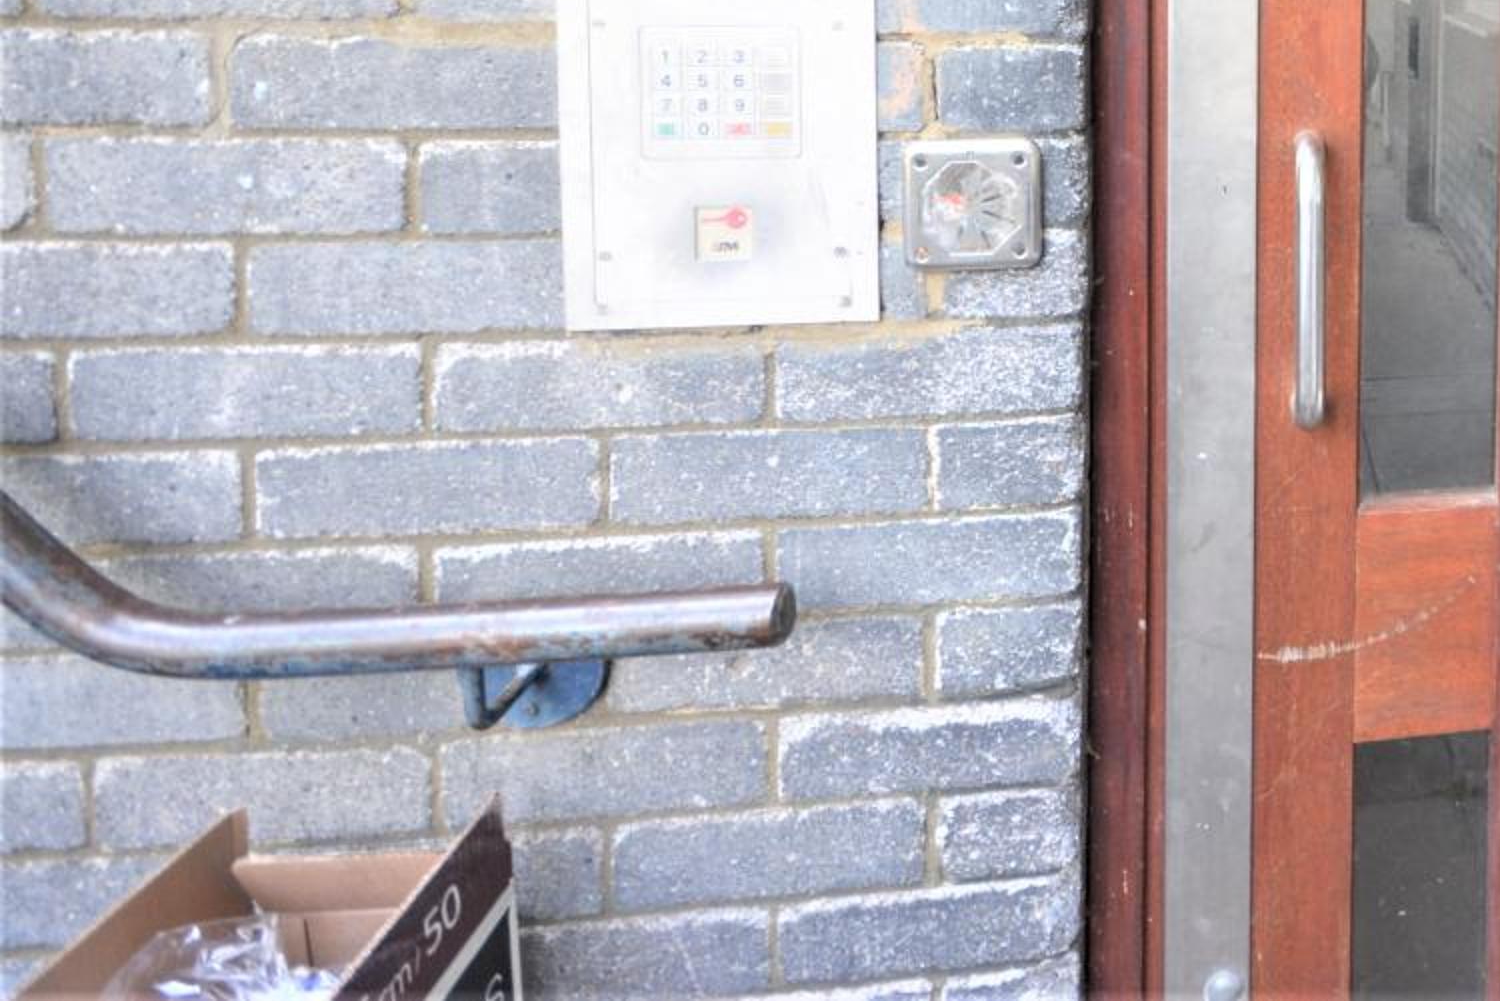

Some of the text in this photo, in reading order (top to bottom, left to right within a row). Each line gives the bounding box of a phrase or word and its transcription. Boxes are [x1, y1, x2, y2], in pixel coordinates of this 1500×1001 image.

[696, 50, 708, 63] 2
[734, 50, 746, 63] 3
[660, 74, 745, 88] 4 5 6
[660, 99, 746, 112] 7 8 9
[698, 123, 710, 137] 0
